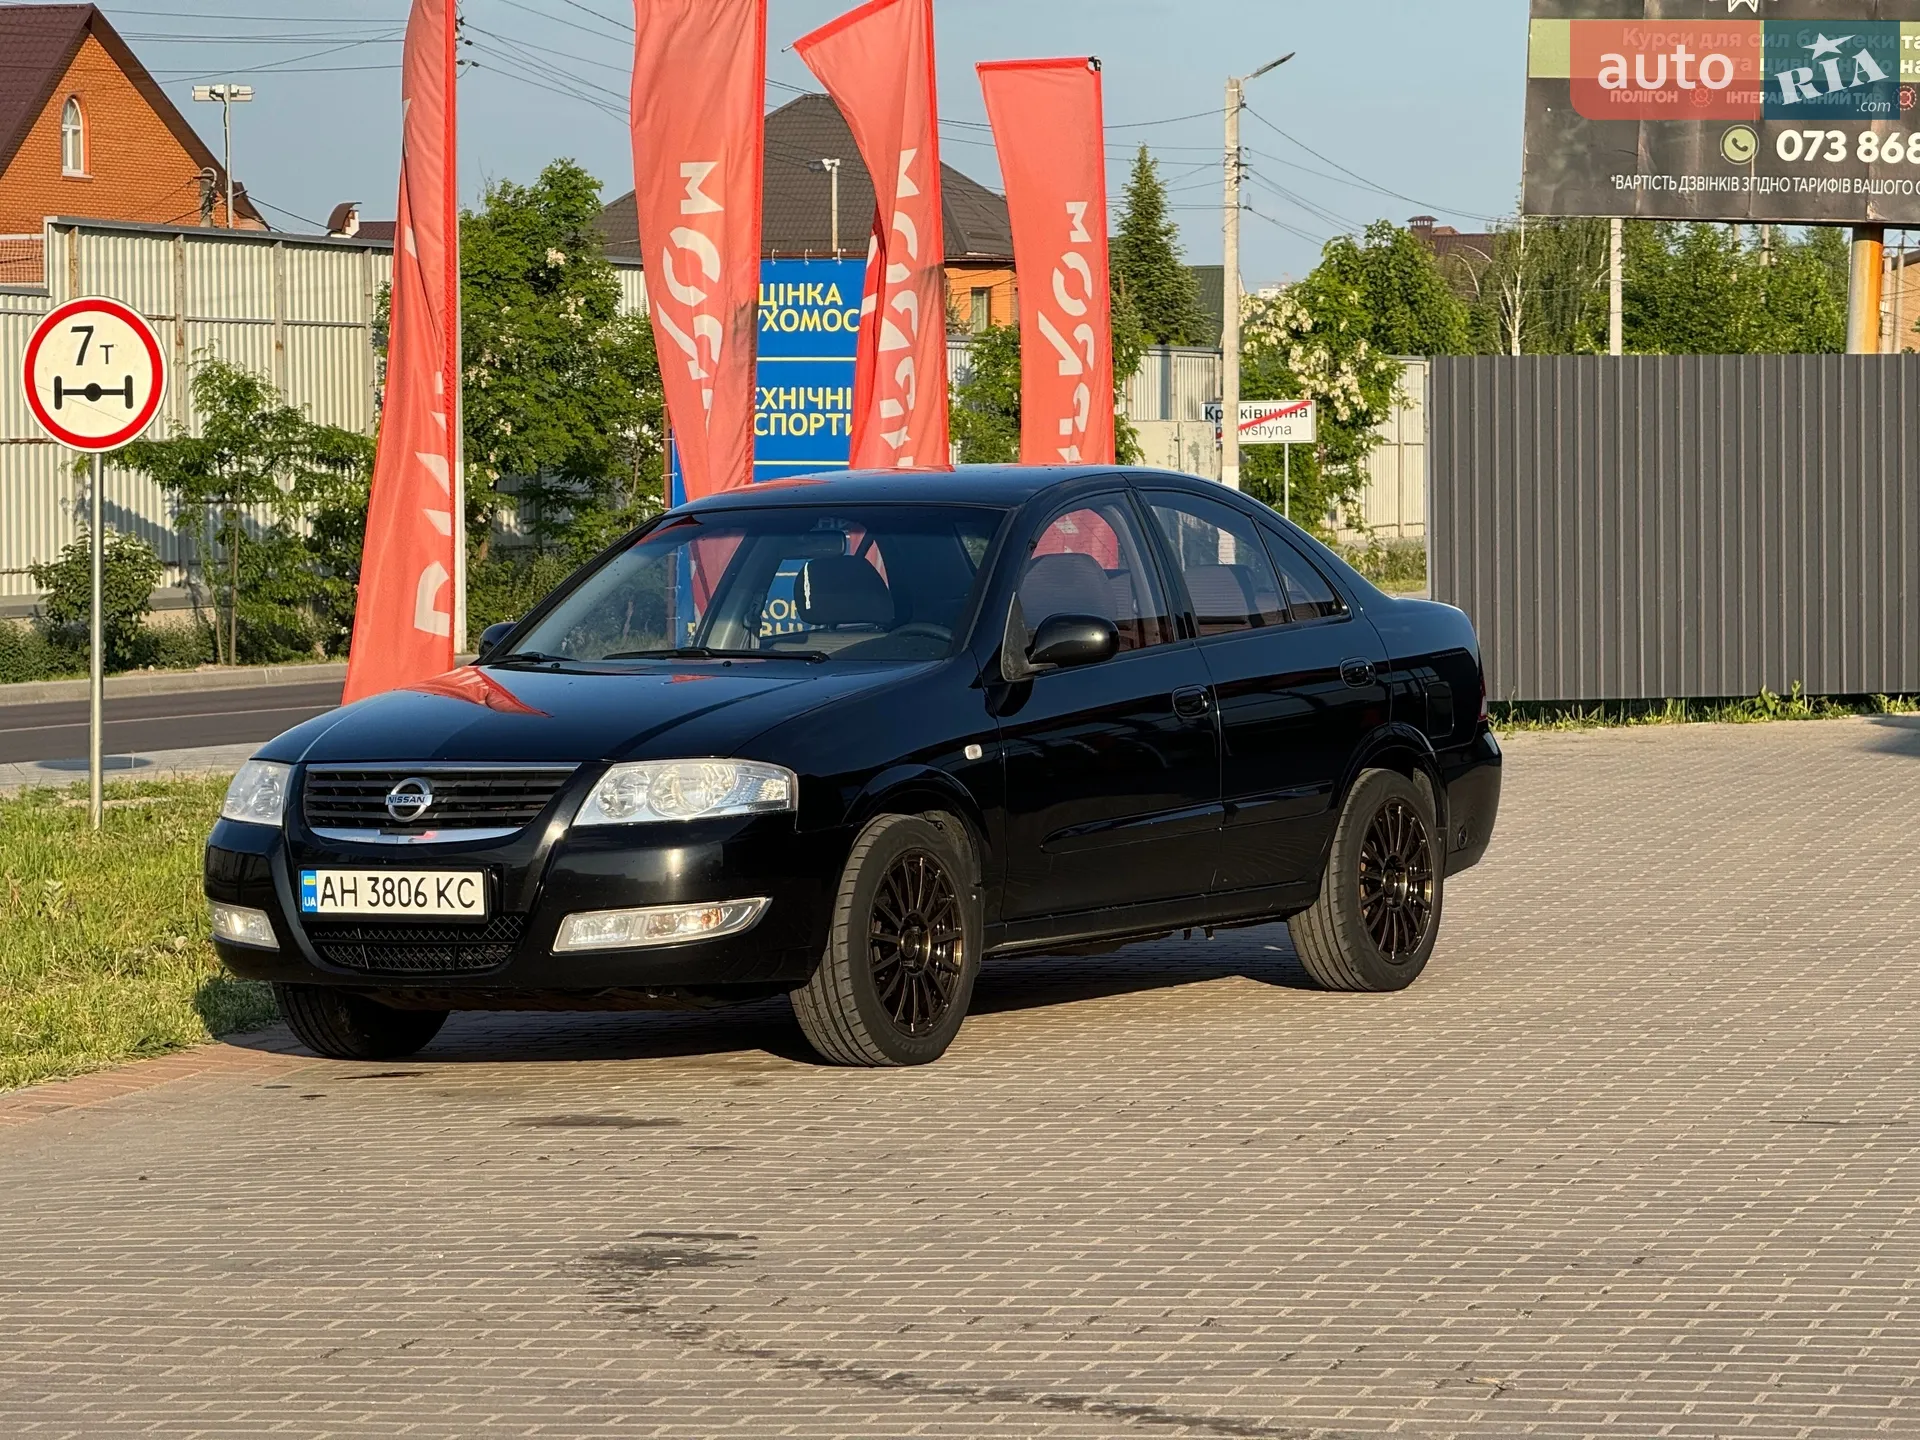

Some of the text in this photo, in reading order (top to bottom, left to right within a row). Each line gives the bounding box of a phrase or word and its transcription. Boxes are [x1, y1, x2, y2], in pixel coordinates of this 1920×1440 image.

[1622, 27, 1694, 51] Курси
[1699, 32, 1741, 50] для
[1747, 33, 1791, 48] сил
[1610, 90, 1679, 103] ПОЛІГОН
[1776, 129, 1920, 165] 073 868
[1678, 175, 1740, 193] ДЗВІНКІВ
[1741, 176, 1791, 194] ЗГІДНО
[1793, 176, 1851, 194] ТАРИФІВ
[1853, 178, 1913, 196] ВАШОГО
[757, 308, 860, 332] ХОМОС
[387, 795, 426, 804] NISSAN
[304, 896, 317, 907] UA
[320, 876, 358, 907] AH
[366, 877, 428, 908] 3806
